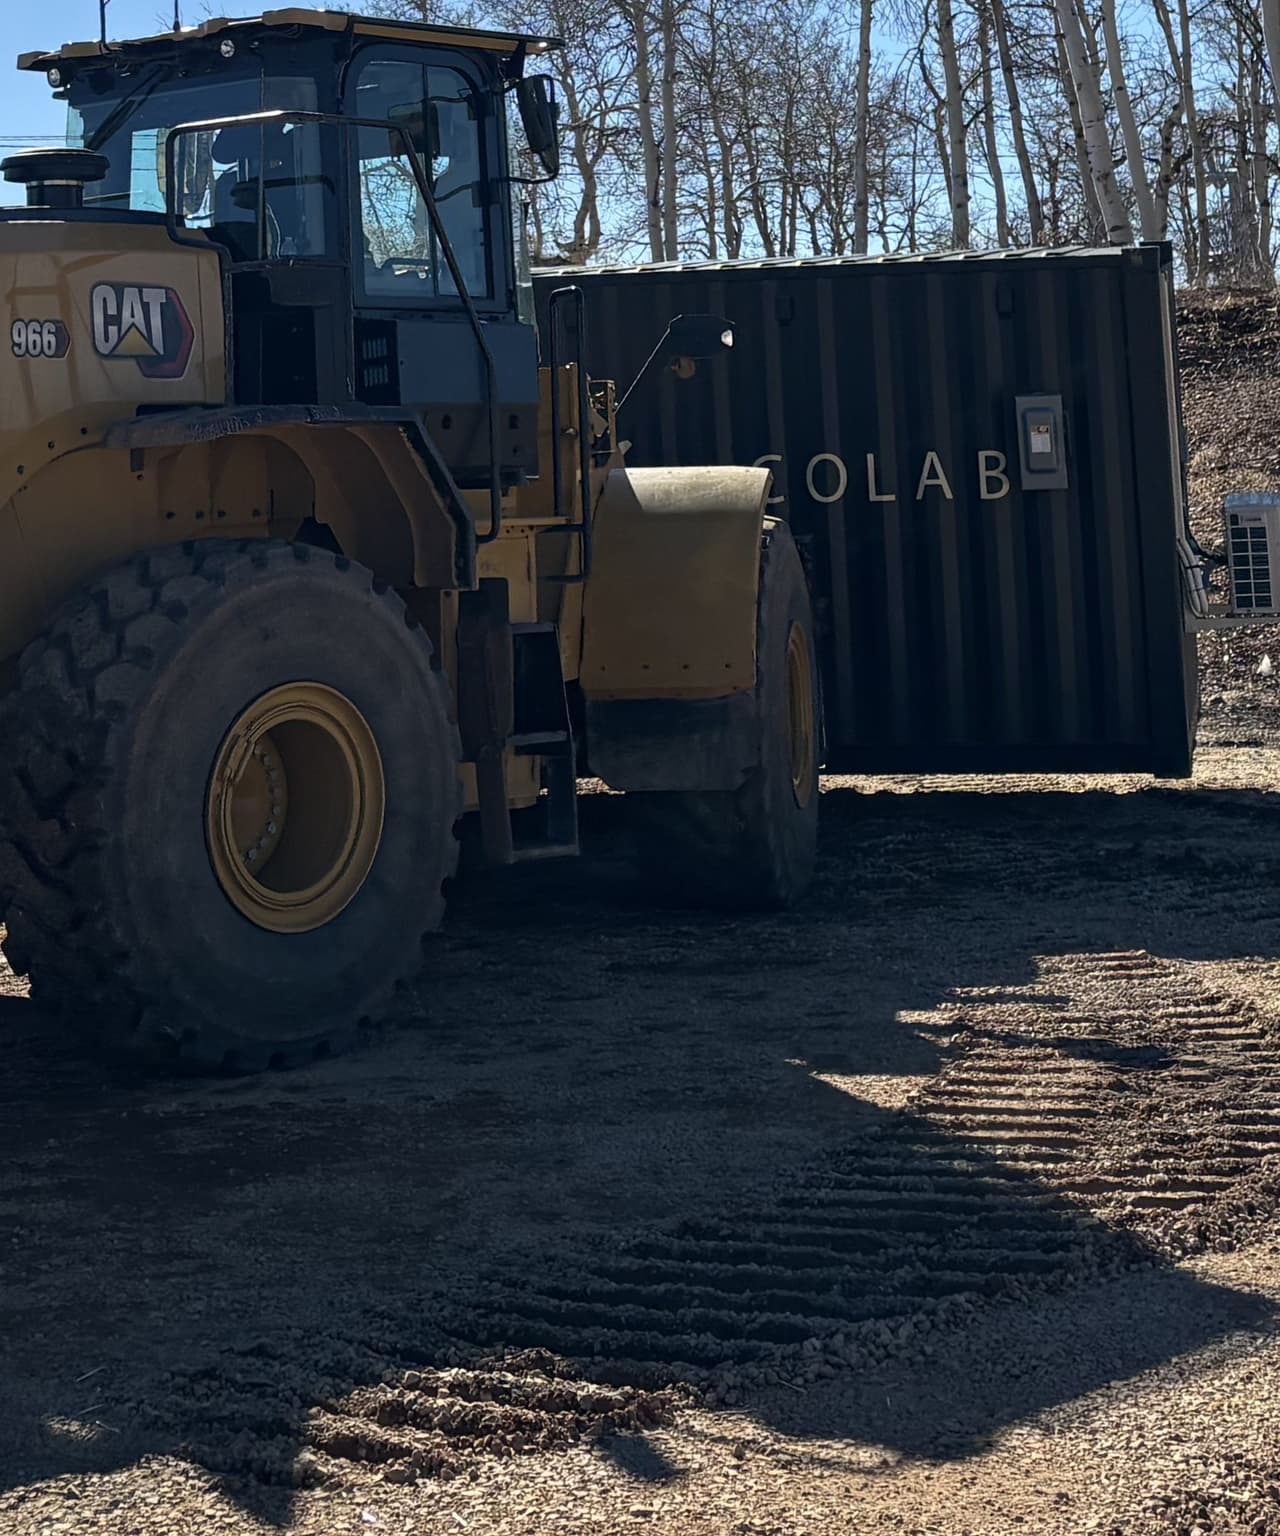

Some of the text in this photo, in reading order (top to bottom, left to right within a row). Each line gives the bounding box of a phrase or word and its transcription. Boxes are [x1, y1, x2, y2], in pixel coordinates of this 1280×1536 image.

[12, 320, 57, 356] 966
[92, 284, 167, 356] CAT
[754, 450, 1011, 504] COLAB
